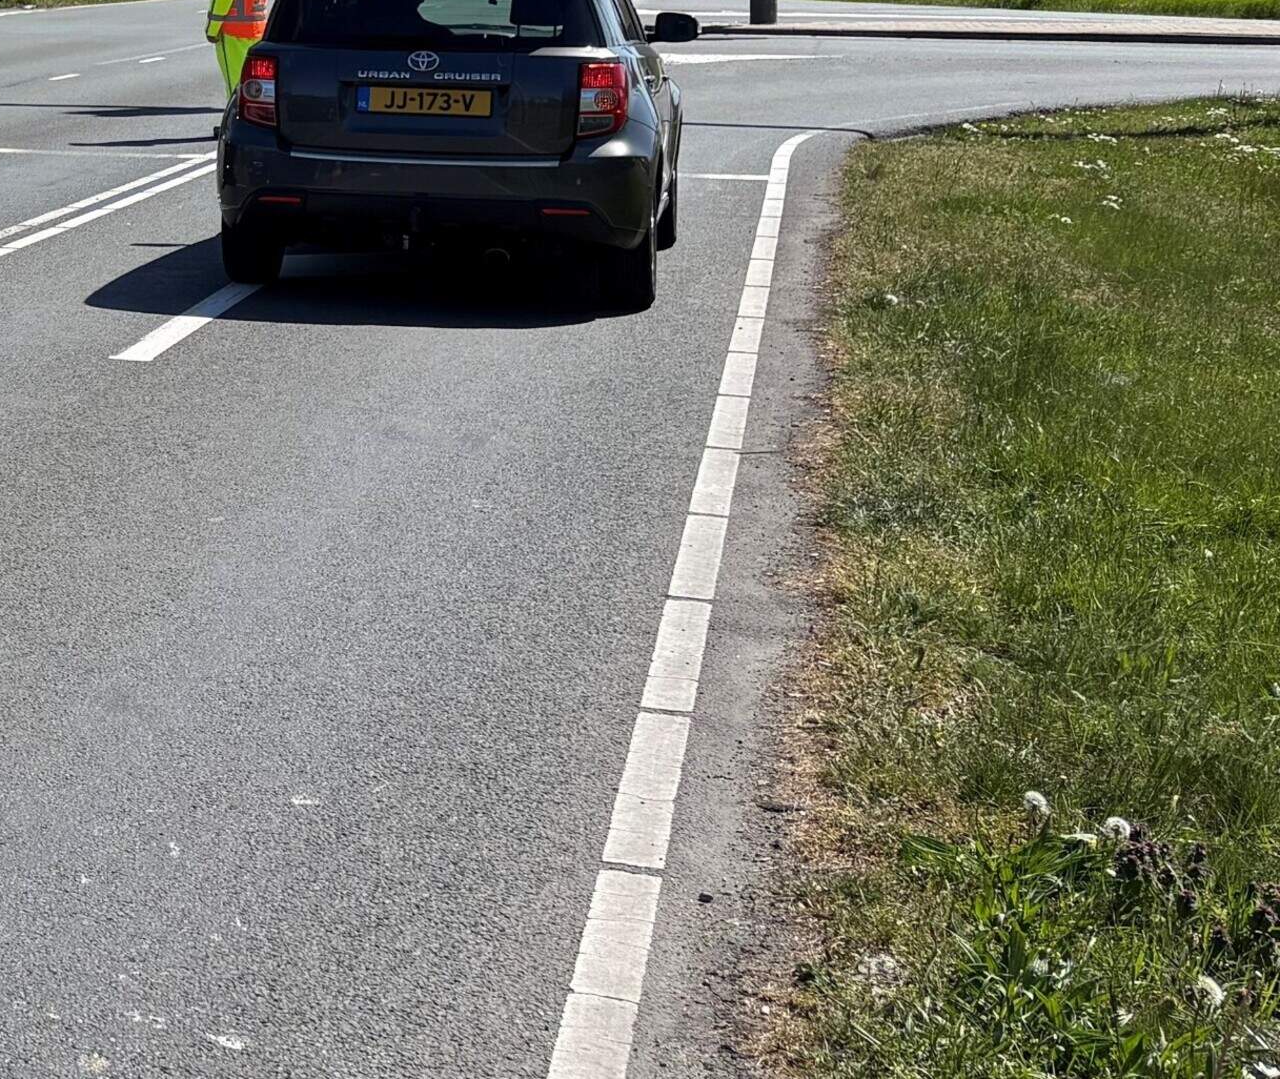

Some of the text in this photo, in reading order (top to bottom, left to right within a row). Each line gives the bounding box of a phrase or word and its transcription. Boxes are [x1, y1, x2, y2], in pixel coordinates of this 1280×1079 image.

[358, 70, 501, 81] URBAN CRUISER
[384, 90, 476, 113] JJ-173-V
